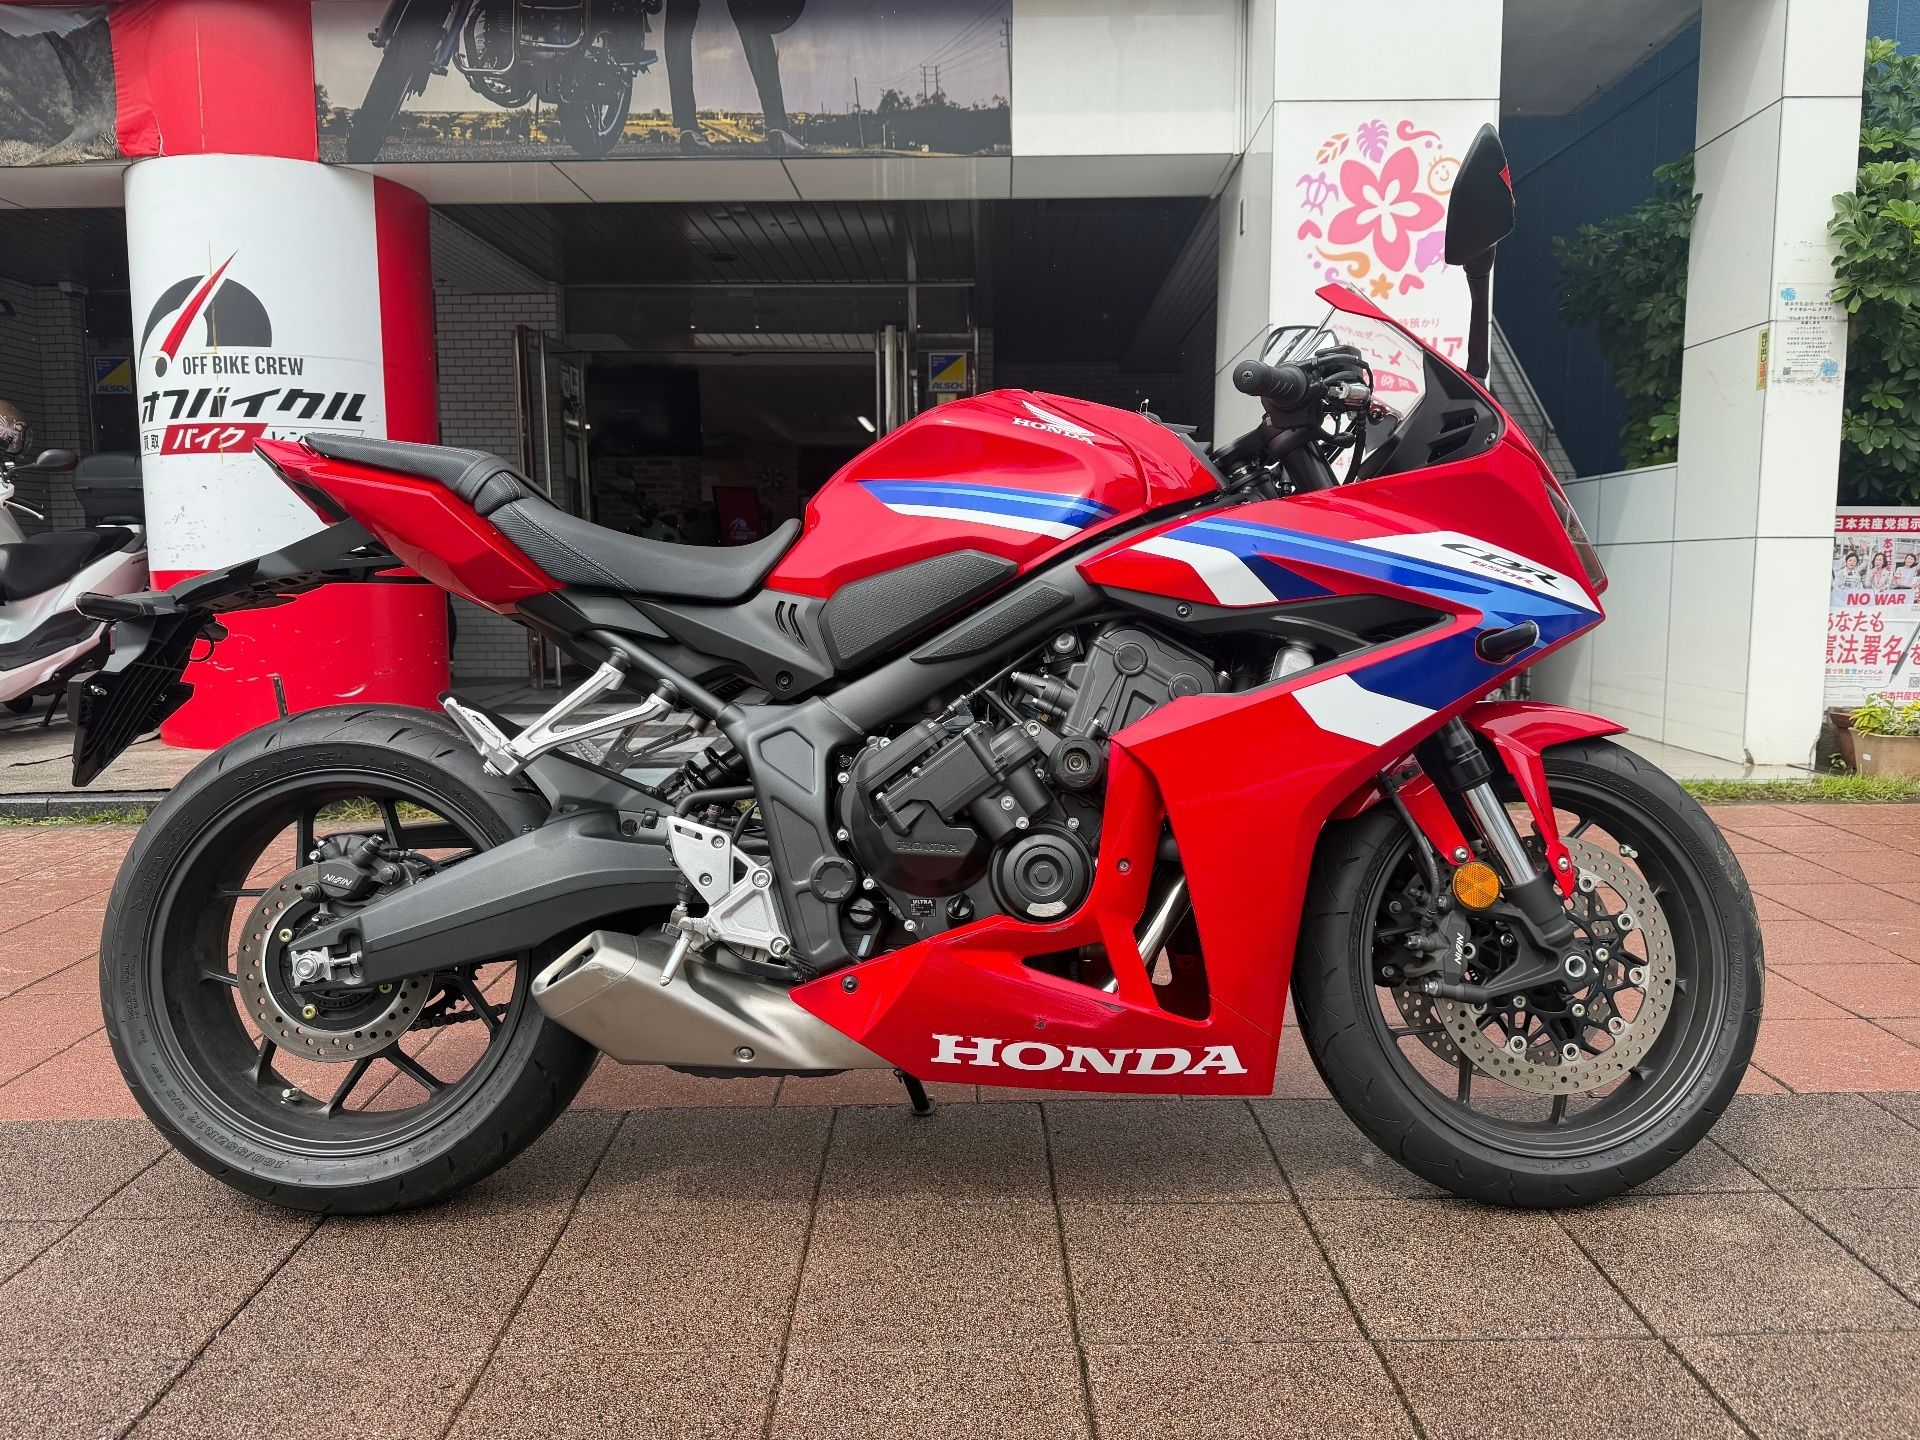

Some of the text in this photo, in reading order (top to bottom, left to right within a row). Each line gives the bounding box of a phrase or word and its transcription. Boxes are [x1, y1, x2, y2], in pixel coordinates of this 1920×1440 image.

[183, 355, 304, 376] OFF BIKE CREW
[931, 382, 964, 390] ALSOK
[142, 386, 367, 424] オフバイクル
[172, 427, 246, 450] バイク
[1012, 417, 1096, 447] HONDA
[1440, 543, 1562, 592] CBR
[1846, 593, 1907, 606] NO WAR
[897, 841, 962, 854] HONDA
[322, 873, 354, 887] NISSIN
[930, 1032, 1249, 1076] HONDA
